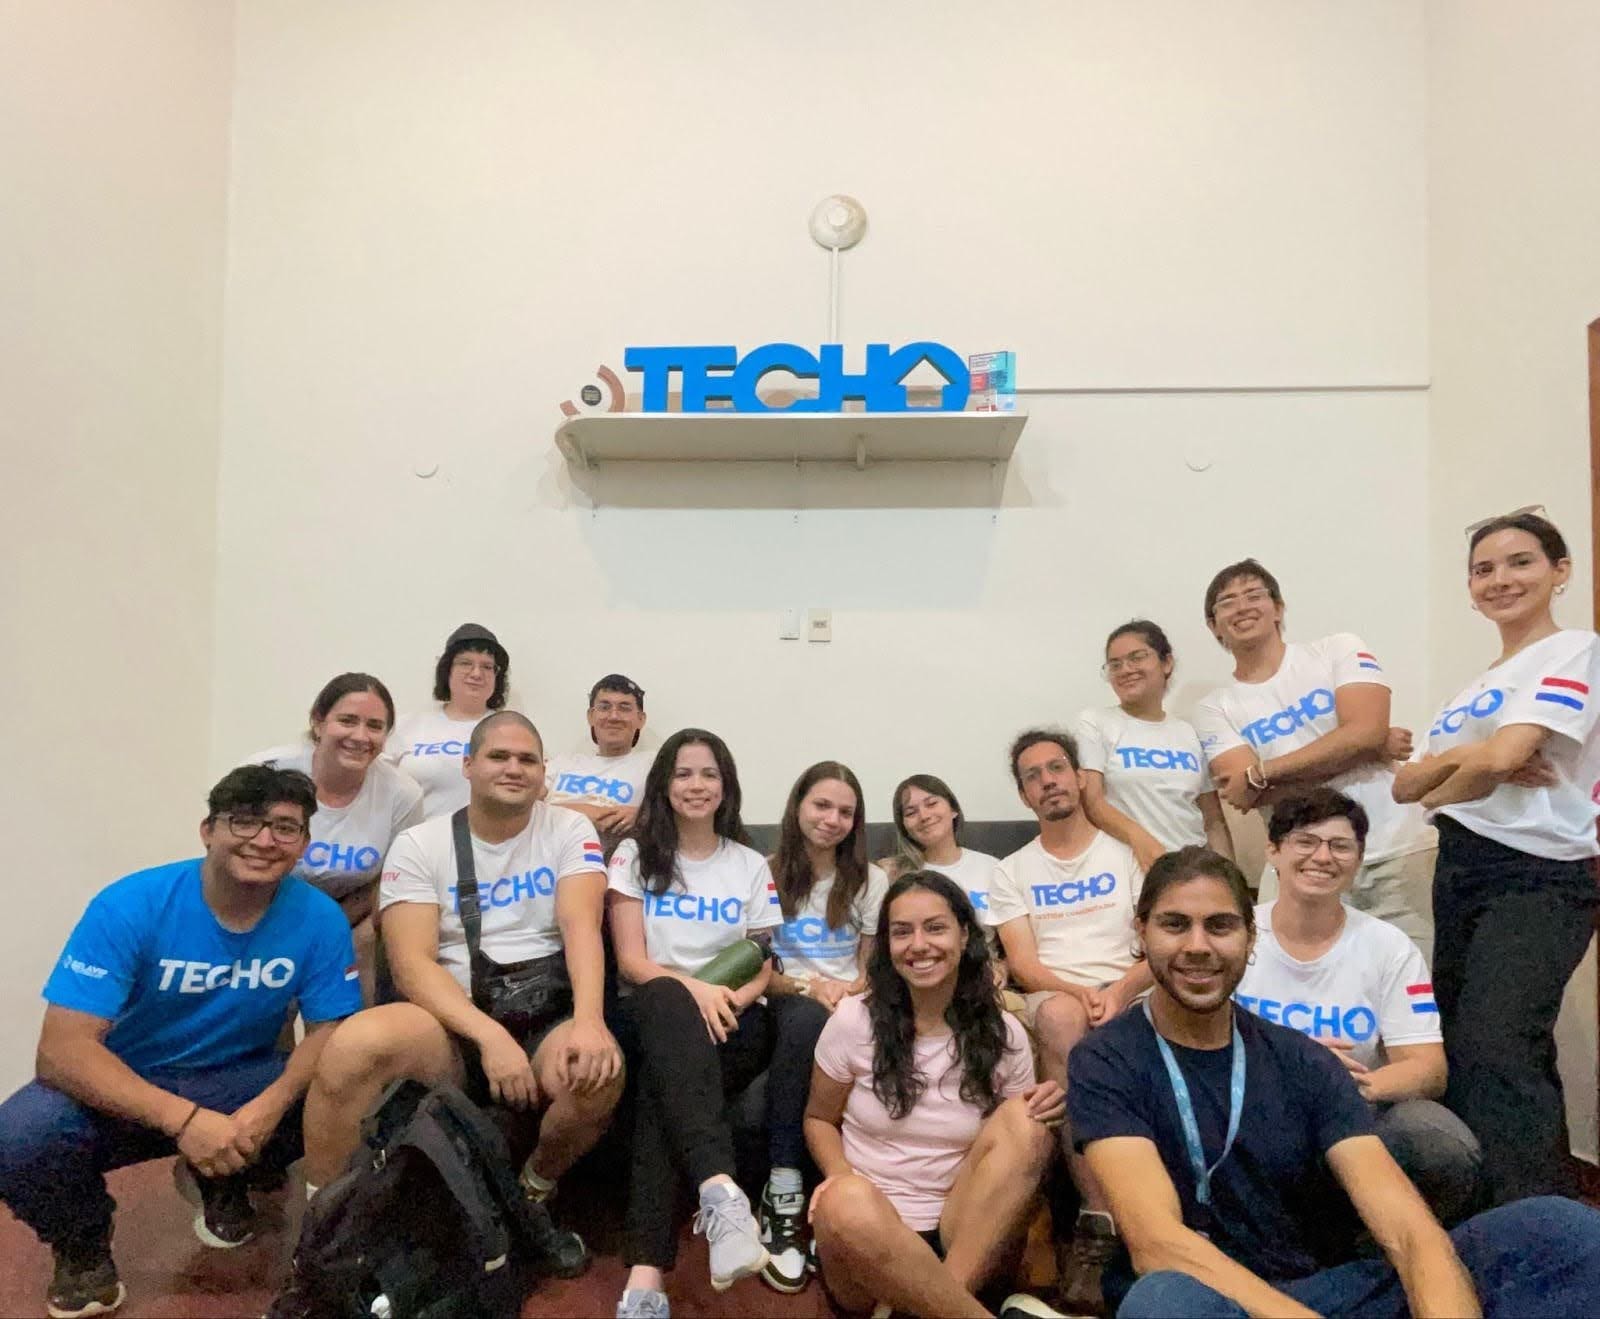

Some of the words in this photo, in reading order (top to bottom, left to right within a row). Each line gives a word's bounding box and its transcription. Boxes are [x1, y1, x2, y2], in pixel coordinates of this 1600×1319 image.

[625, 342, 969, 413] TECHO
[1241, 688, 1335, 748] TECHO
[1116, 747, 1200, 772] TECHO
[556, 773, 634, 803] TECHO
[303, 841, 380, 871] CHO
[1031, 872, 1116, 906] TECHO
[158, 957, 296, 993] TECHO
